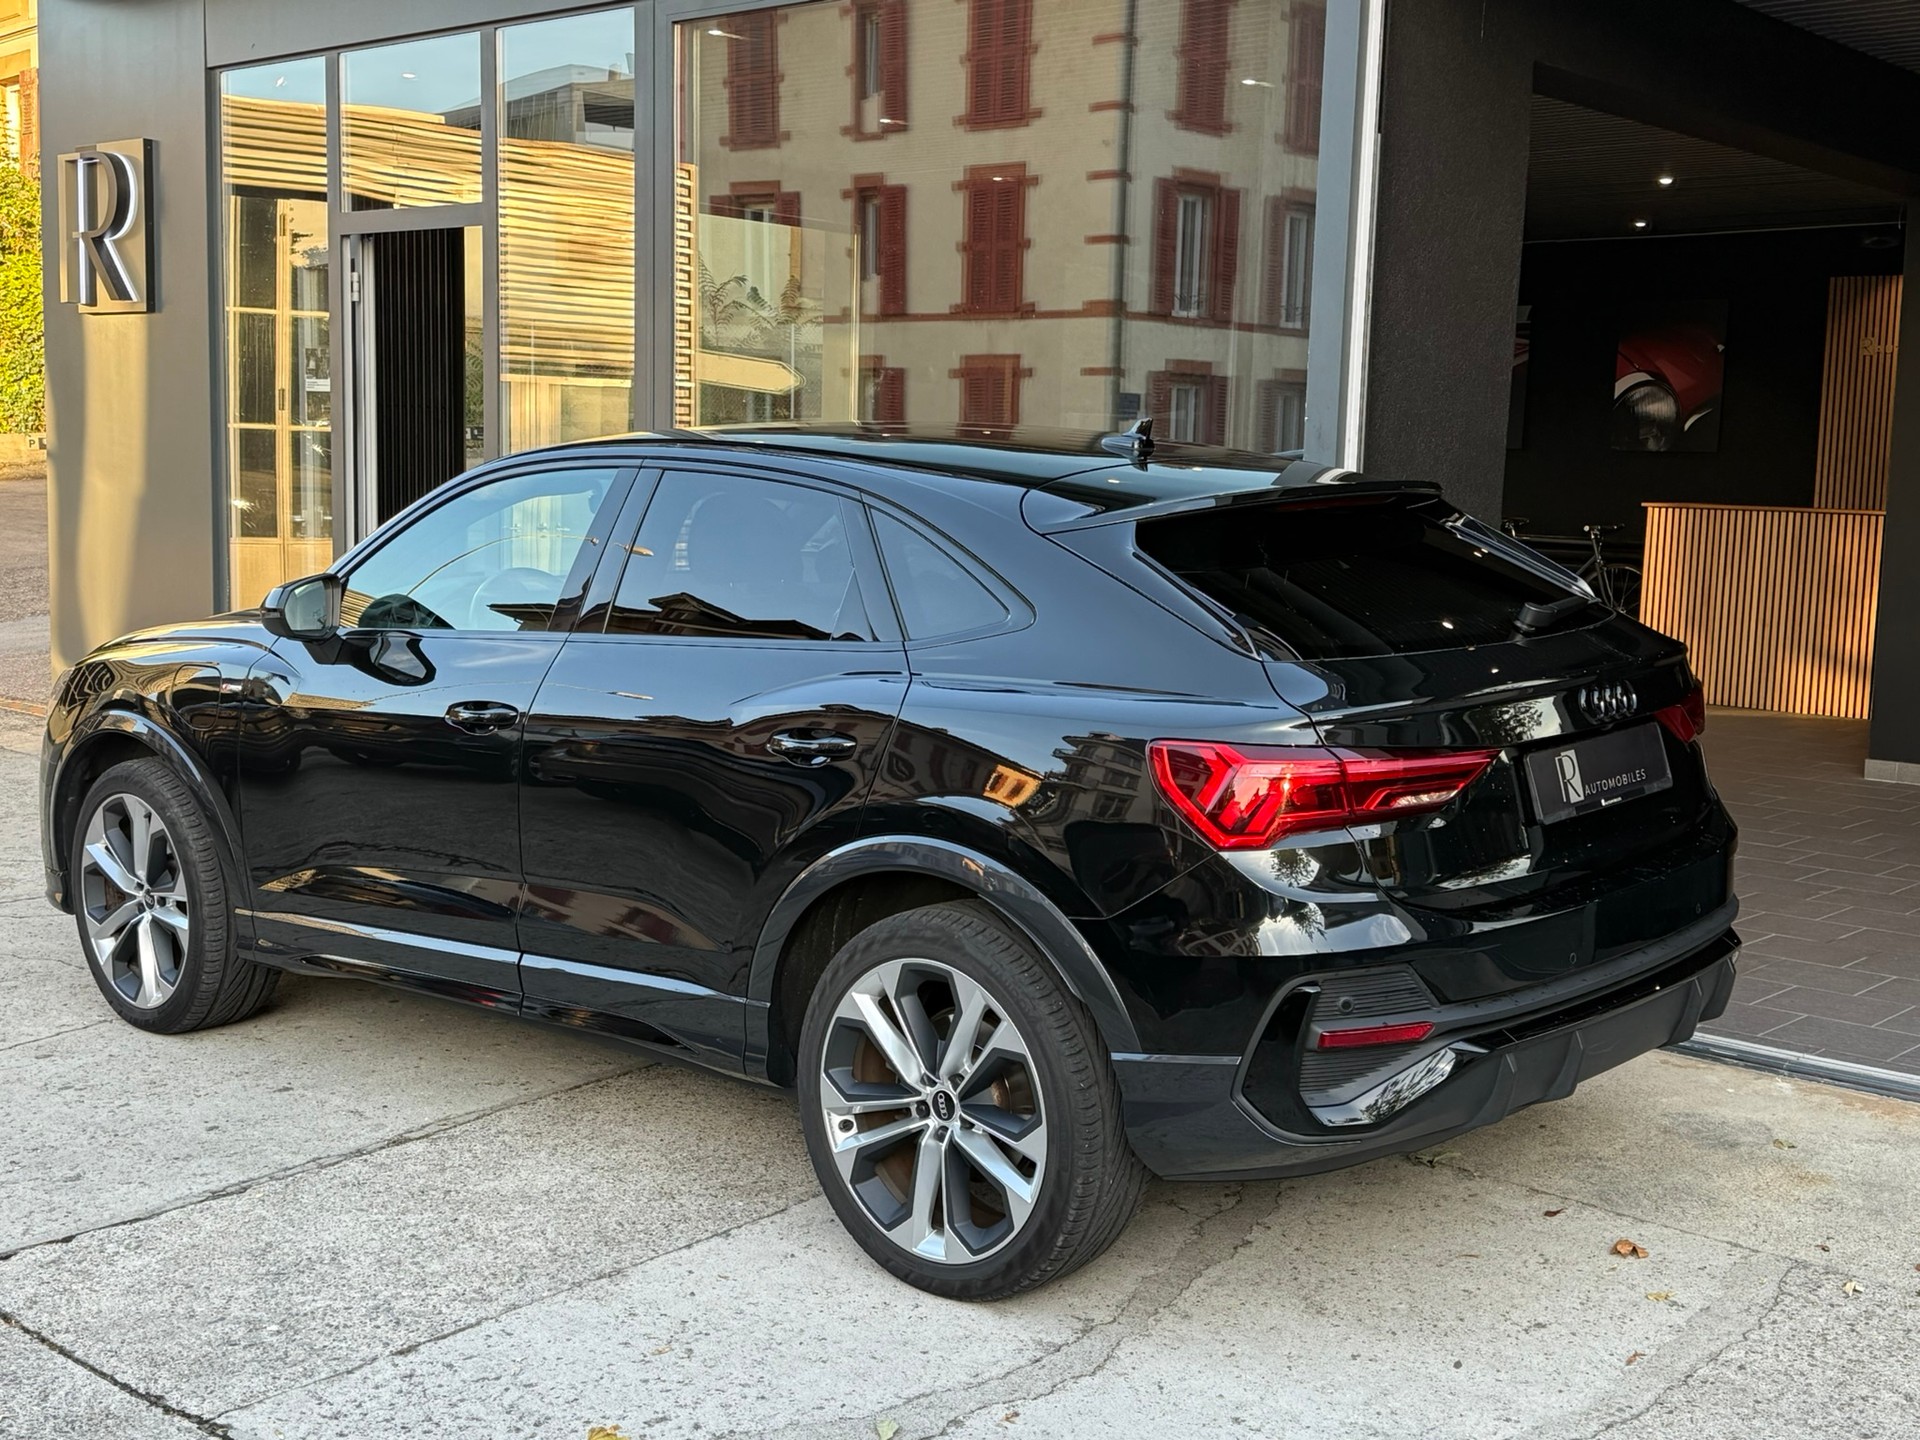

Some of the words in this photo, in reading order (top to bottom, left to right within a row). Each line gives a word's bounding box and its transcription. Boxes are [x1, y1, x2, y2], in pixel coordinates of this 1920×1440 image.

[57, 151, 139, 306] R
[1555, 750, 1584, 803] R
[1585, 769, 1646, 795] AUTOMOBILES
